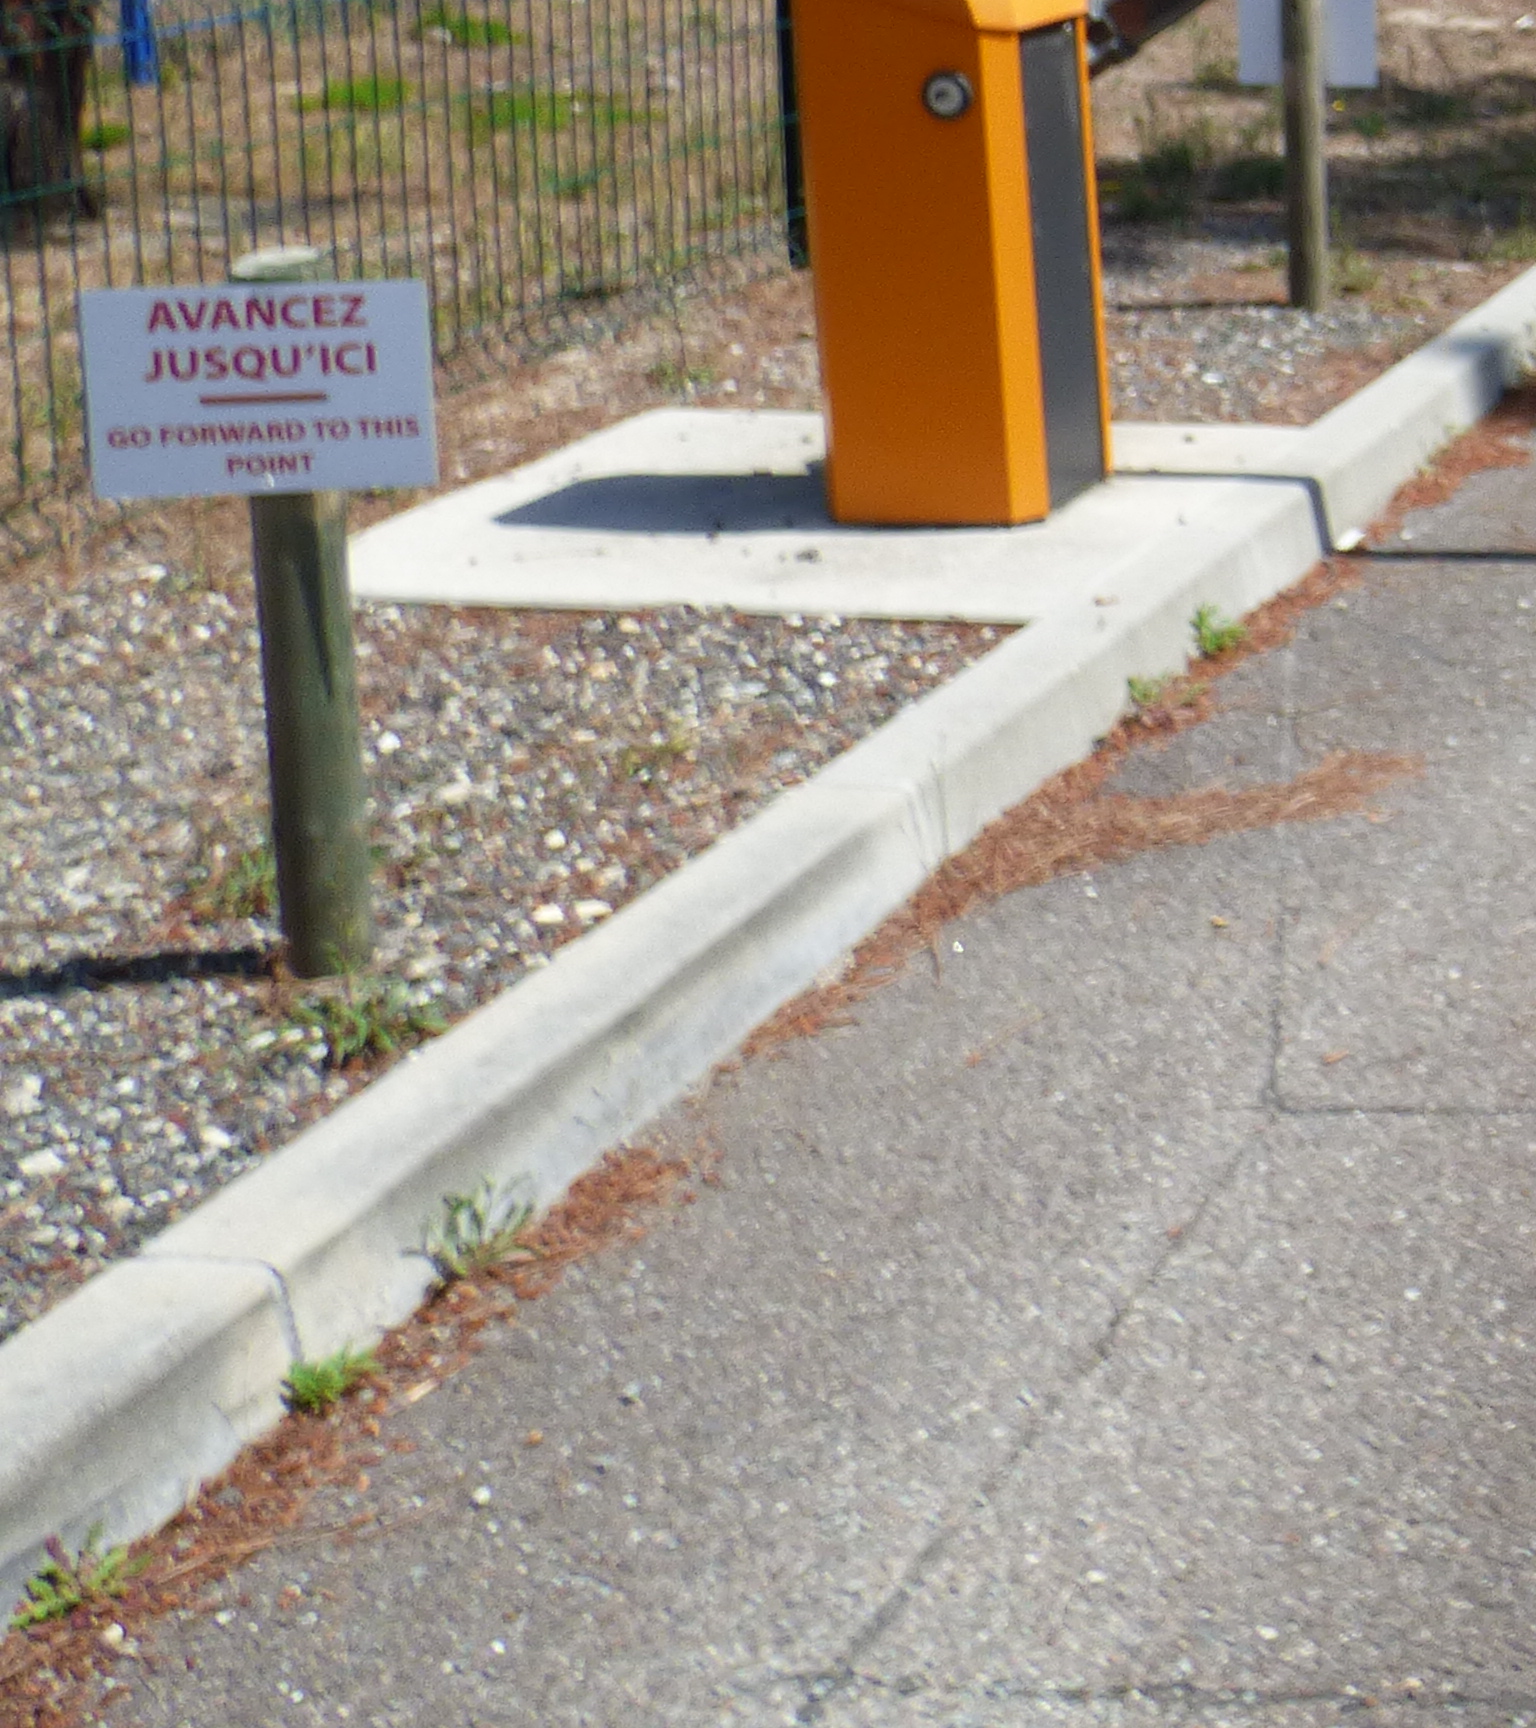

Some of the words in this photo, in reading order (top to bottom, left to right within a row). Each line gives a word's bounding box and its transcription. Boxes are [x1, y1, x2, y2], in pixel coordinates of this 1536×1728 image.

[147, 294, 367, 334] AVANCEZ
[145, 341, 378, 383] JUSQU'ICI
[107, 425, 151, 449] GO
[159, 421, 306, 447] FORWARD
[314, 418, 350, 441] TO
[358, 415, 420, 439] THIS
[225, 452, 314, 476] POINT
